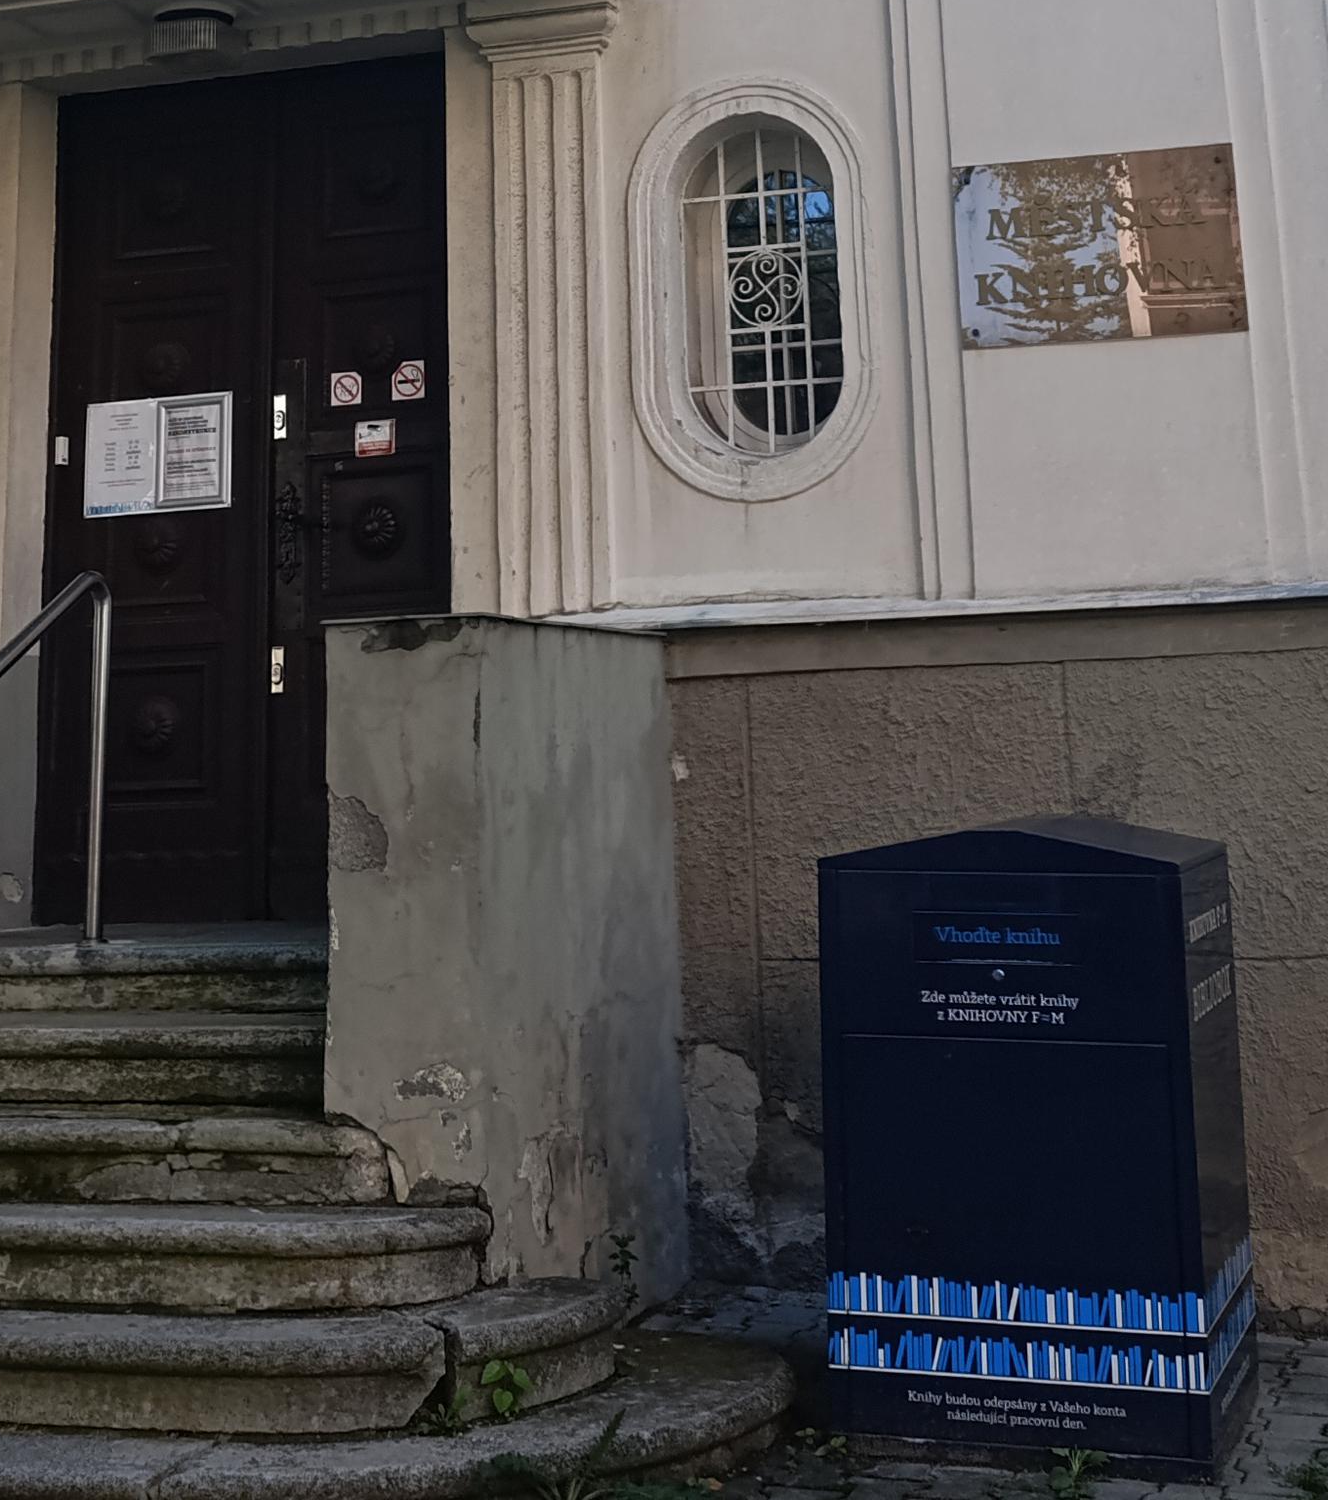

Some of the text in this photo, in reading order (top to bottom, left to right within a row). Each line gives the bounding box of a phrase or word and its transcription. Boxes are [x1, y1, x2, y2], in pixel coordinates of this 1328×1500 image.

[986, 191, 1208, 241] MĚSTSKÁ
[974, 258, 1230, 306] KNIHOVNA
[932, 925, 1062, 945] Vhoďte knihu
[920, 990, 1080, 1010] Zde můžete vrátit knihy
[937, 1011, 945, 1021] z
[948, 1009, 1029, 1023] KNIHOVNY
[907, 1389, 1128, 1418] Knihy budou odepsány z Vašeho konta
[946, 1408, 1088, 1430] následující pracovní den.
